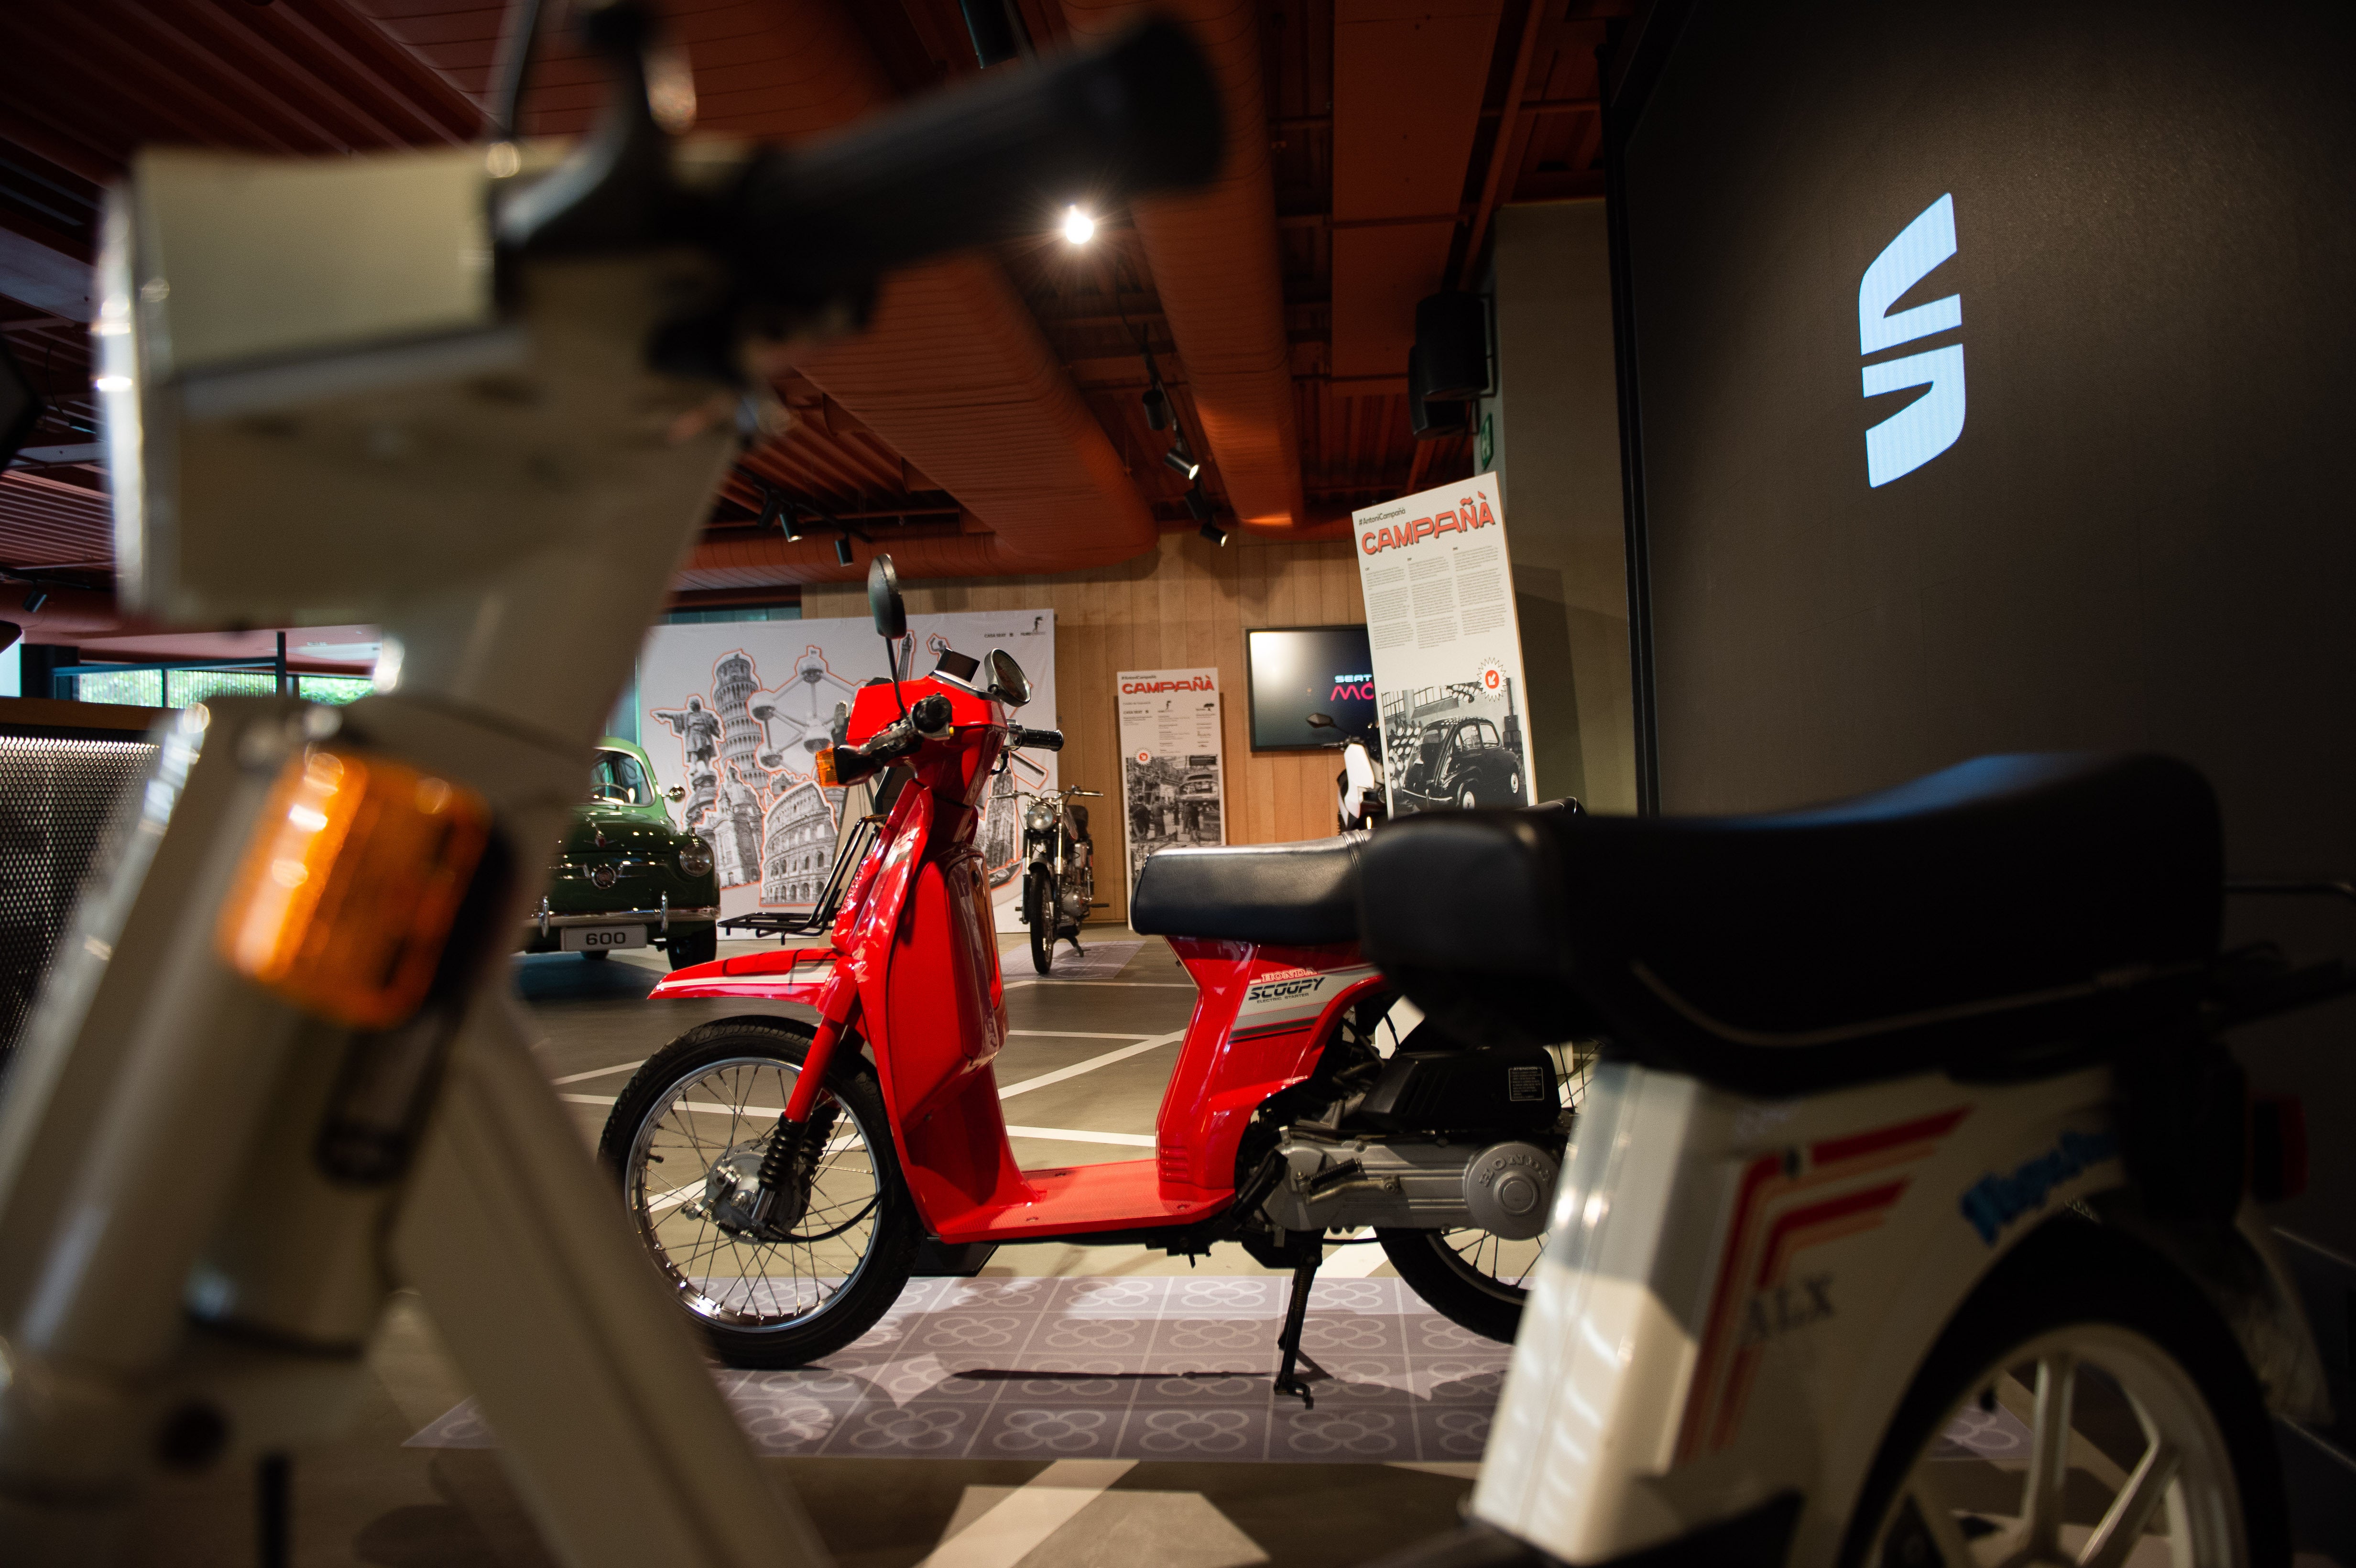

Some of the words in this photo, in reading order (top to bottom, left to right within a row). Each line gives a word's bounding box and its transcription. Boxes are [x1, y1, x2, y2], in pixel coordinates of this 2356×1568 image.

[1362, 490, 1495, 555] CAMPAÑÀ
[1122, 675, 1215, 694] CAMPAÑÀ
[1334, 674, 1373, 683] SEAT
[586, 932, 626, 946] 600
[1261, 968, 1318, 982] HONDA
[1248, 977, 1326, 1001] SCOOPY
[1479, 1154, 1551, 1188] HONDA
